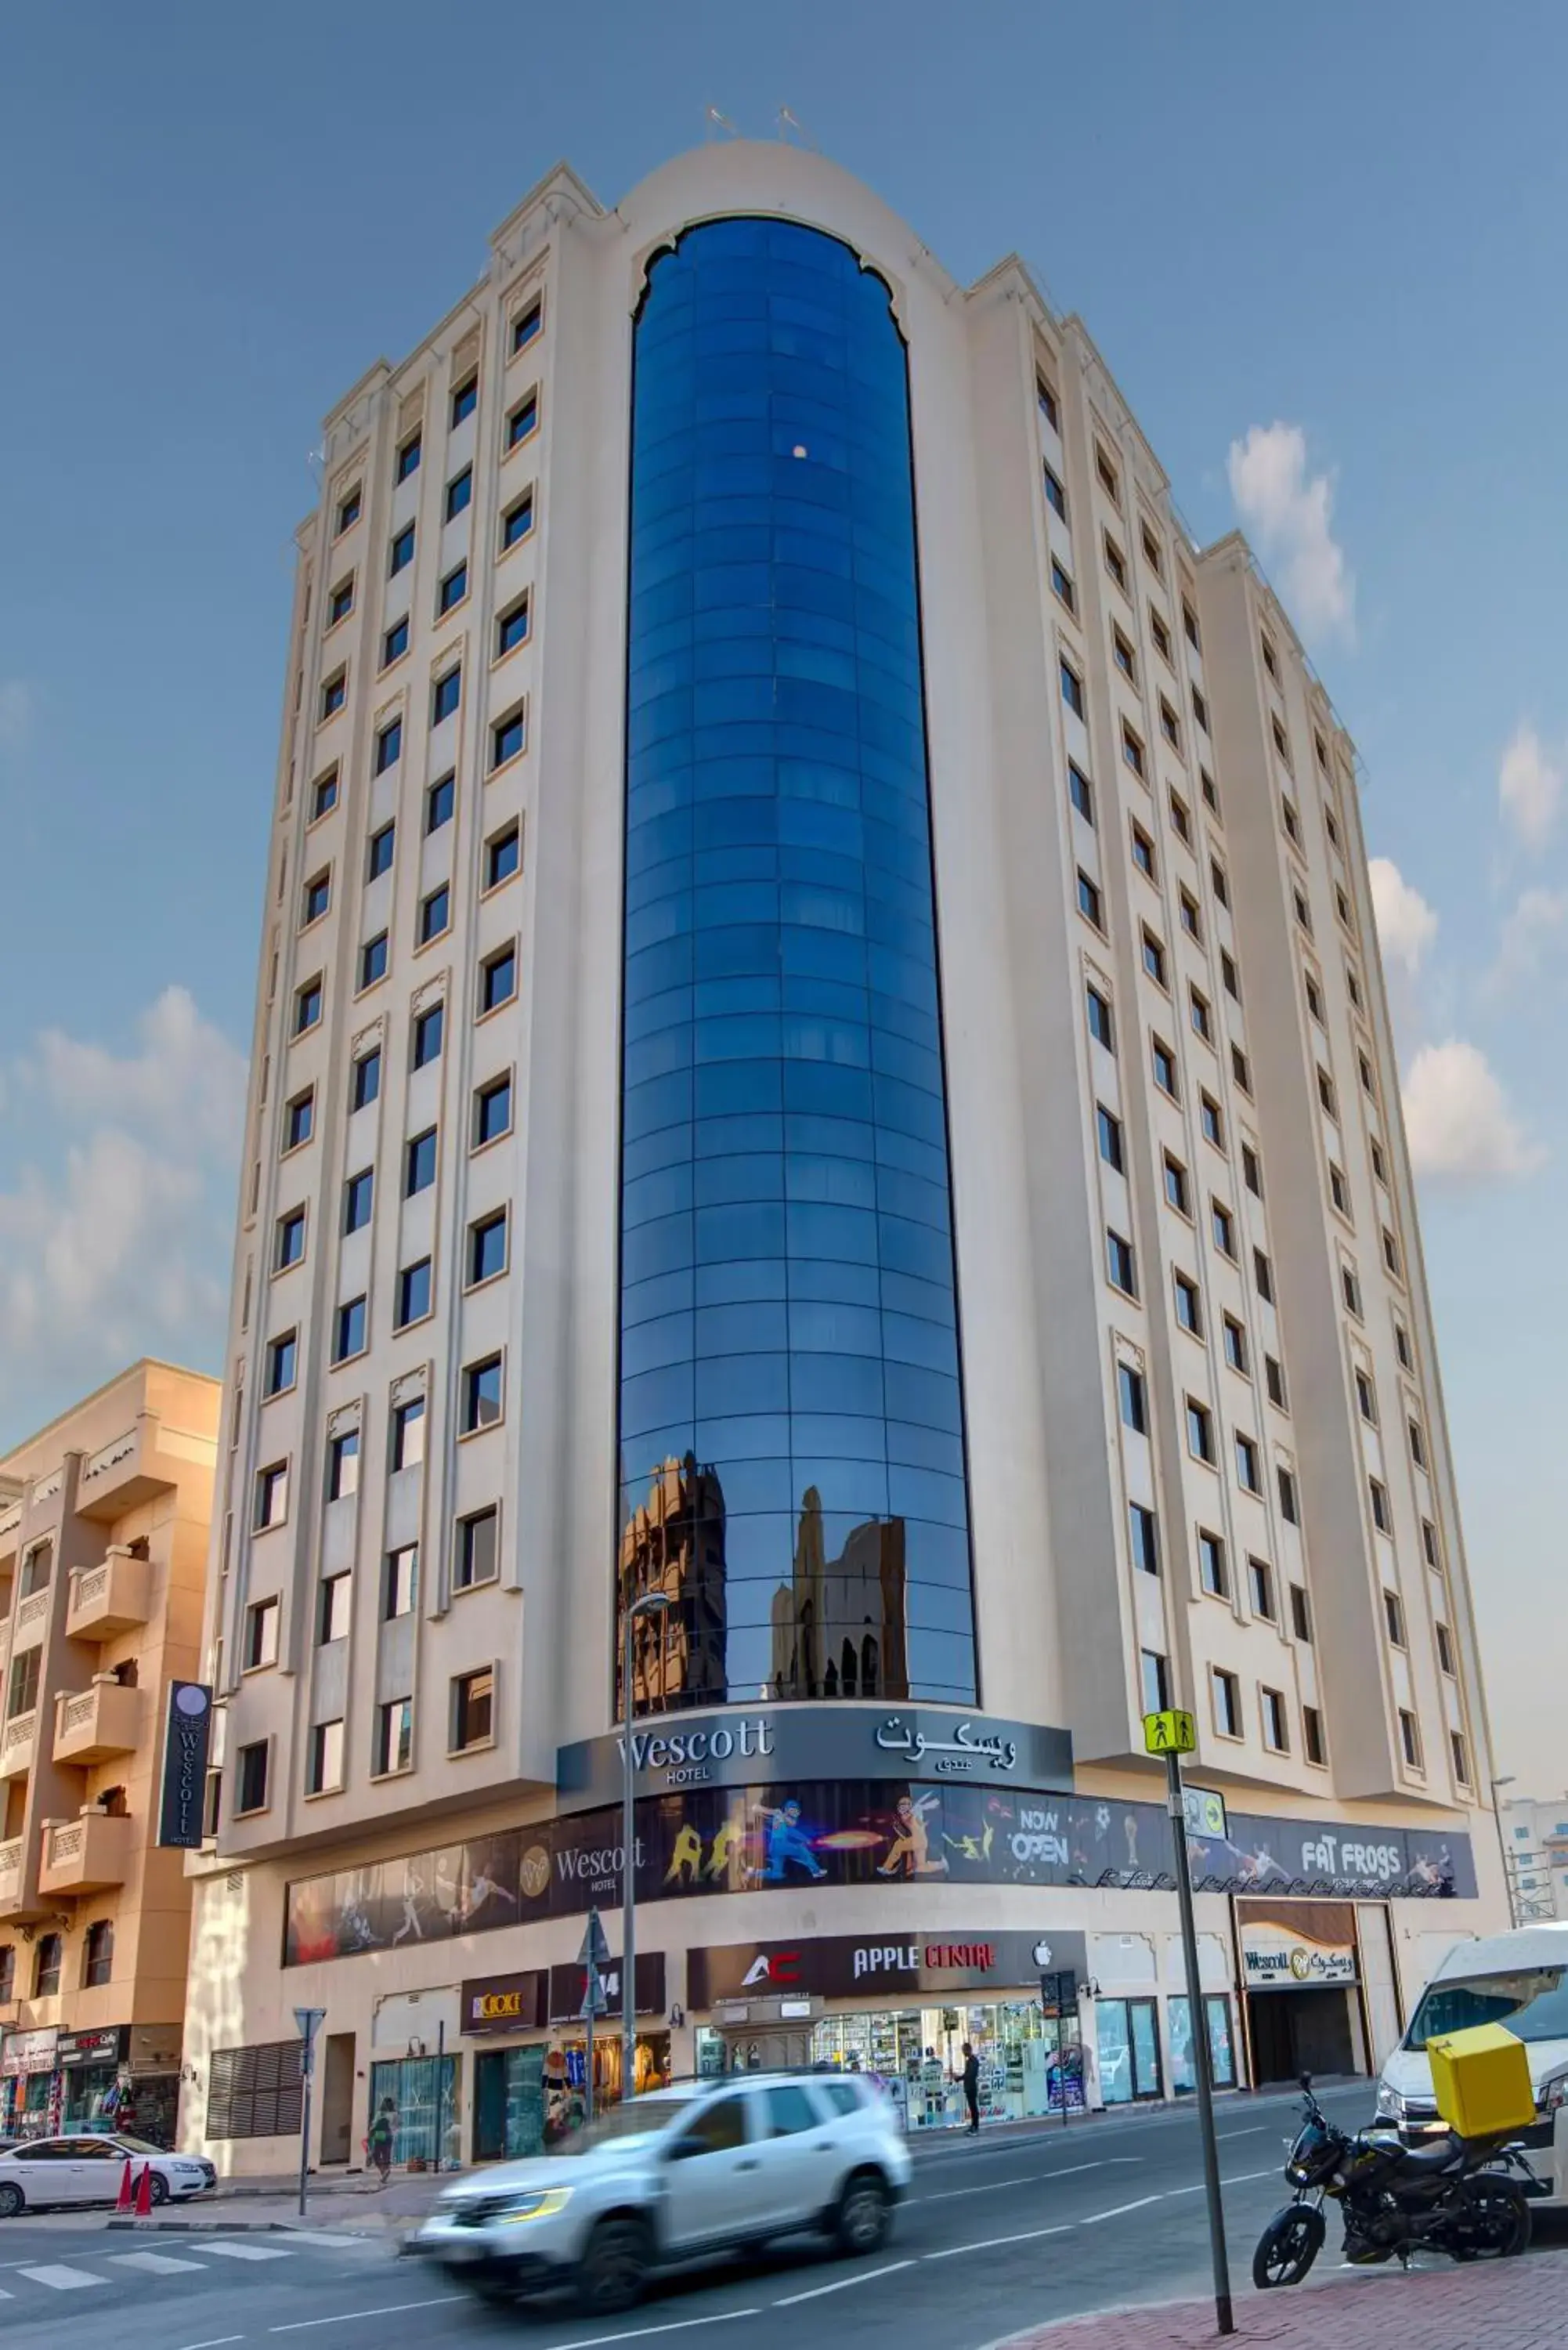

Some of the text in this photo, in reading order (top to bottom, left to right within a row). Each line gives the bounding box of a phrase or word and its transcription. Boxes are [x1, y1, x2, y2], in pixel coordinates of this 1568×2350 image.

[616, 1719, 774, 1770] Wescott
[876, 1716, 1016, 1770] ويسكوت
[666, 1766, 709, 1784] HOTEL
[1020, 1810, 1058, 1831] NOW
[556, 1837, 645, 1880] Wescot
[1011, 1832, 1069, 1864] OPEN
[1302, 1834, 1337, 1874] FAT
[591, 1879, 616, 1893] HOTEL
[741, 1950, 801, 1986] AC
[854, 1943, 997, 1979] APPLE CENTRE
